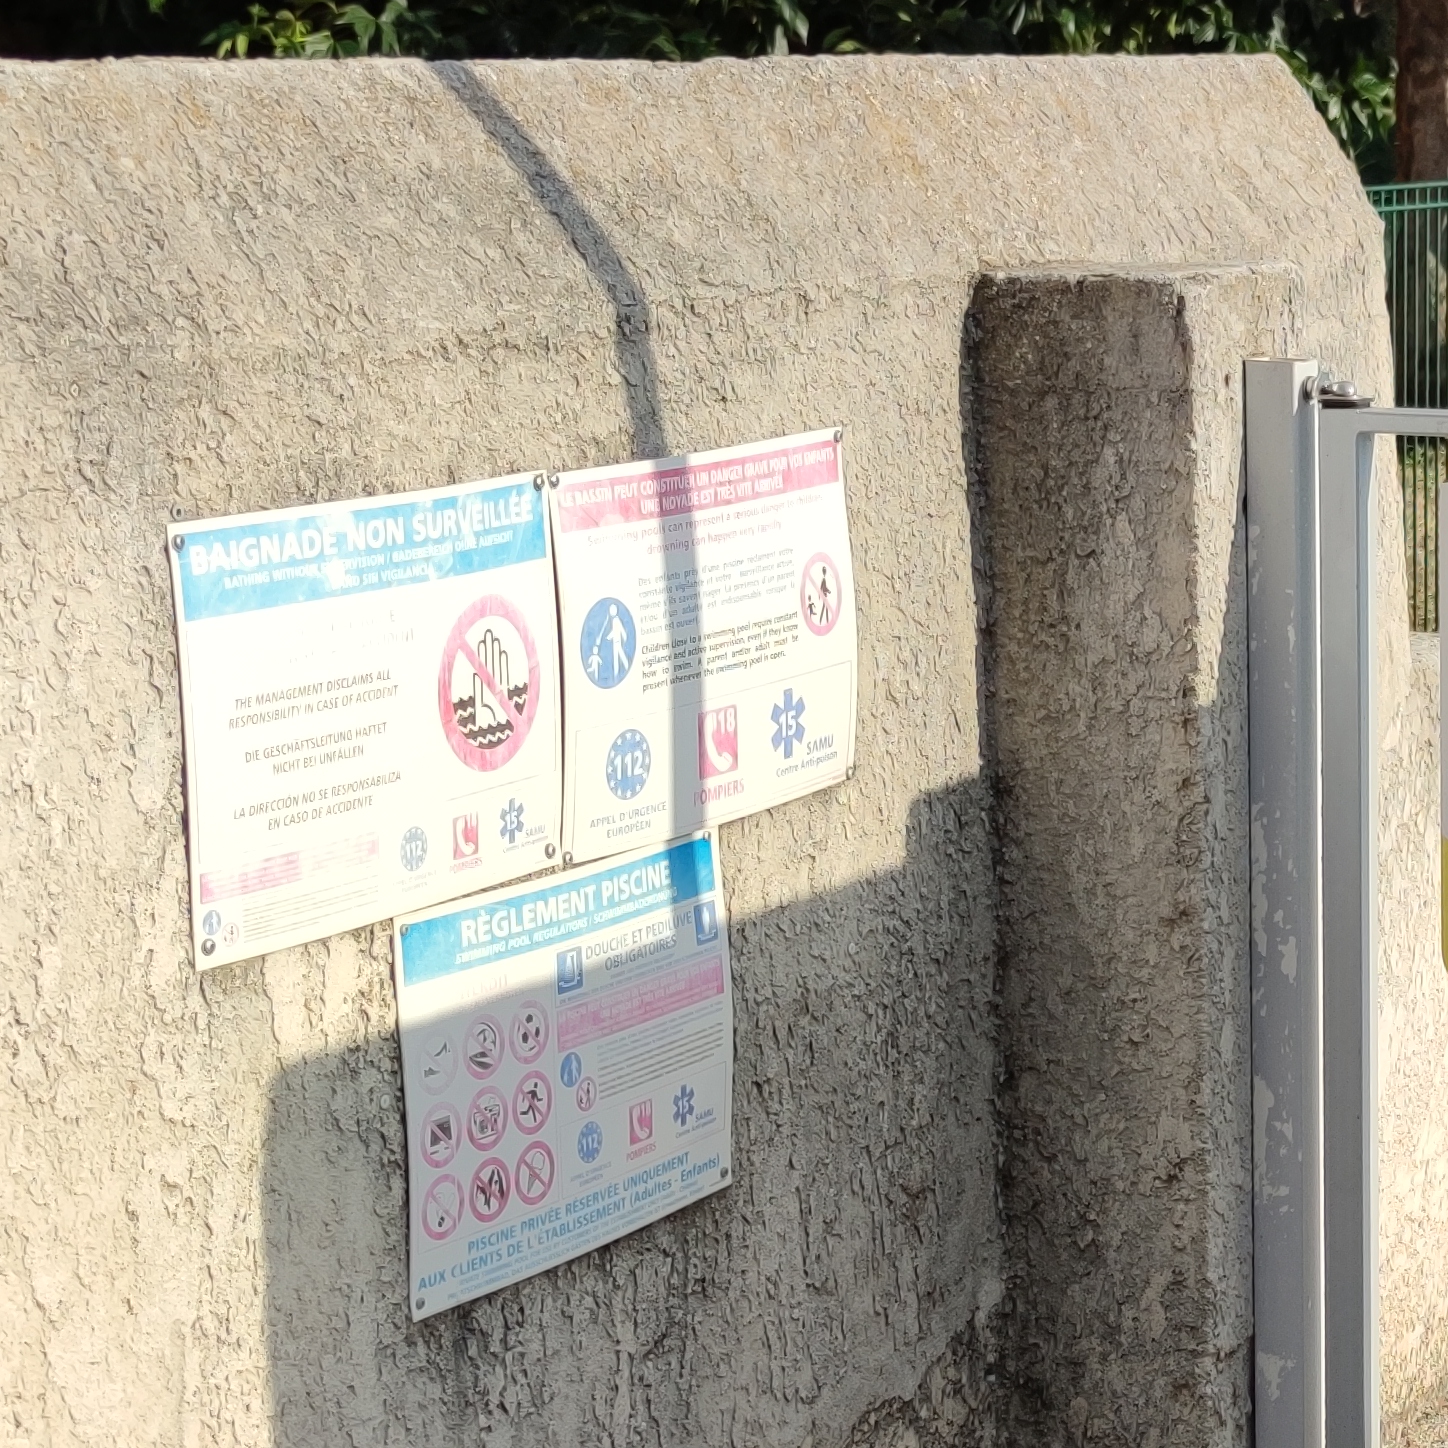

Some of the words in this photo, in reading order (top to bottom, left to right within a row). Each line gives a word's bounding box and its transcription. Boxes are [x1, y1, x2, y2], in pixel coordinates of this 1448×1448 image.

[614, 482, 638, 501] PEUT
[640, 472, 694, 495] CONSTITUER
[697, 470, 708, 486] UN
[712, 464, 742, 484] DANGER
[789, 452, 803, 470] VOS
[640, 498, 660, 515] UNE
[663, 492, 698, 511] NOYADE
[700, 488, 714, 504] EST
[717, 482, 735, 501] TRÈS
[189, 526, 338, 576] BAIGNADE
[347, 517, 405, 551] NON
[412, 489, 533, 542] SURVEILLÉE
[668, 521, 683, 532] can
[647, 538, 689, 554] drowning
[235, 697, 252, 711] THE
[256, 682, 324, 705] MANAGEMENT
[327, 673, 373, 692] DISCLAIMS
[376, 668, 391, 681] ALL
[228, 706, 301, 731] RESPONSIBILITY
[305, 703, 313, 715] IN
[317, 697, 338, 711] CASE
[342, 693, 353, 706] OF
[356, 685, 398, 703] ACCIDENT
[718, 708, 735, 734] 18
[779, 710, 796, 738] 15
[245, 750, 259, 763] DIE
[355, 722, 387, 740] HAFTET
[807, 733, 833, 755] SAMU
[273, 759, 300, 776] NICHT
[303, 756, 316, 768] BEI
[614, 751, 643, 780] 112
[776, 764, 799, 777] Centre
[234, 808, 245, 819] LA
[249, 794, 299, 816] DIRECCIÓN
[302, 791, 315, 805] NO
[318, 788, 329, 800] SE
[332, 770, 401, 797] RESPONSABILIZA
[694, 778, 744, 807] POMPIERS
[268, 818, 280, 830] EN
[284, 811, 308, 827] CASO
[312, 807, 323, 820] DE
[326, 795, 373, 816] ACCIDENTE
[506, 811, 518, 830] 15
[590, 812, 616, 828] APPEL
[620, 801, 667, 822] D'URGENCE
[607, 819, 651, 838] EUROPÉEN
[460, 884, 597, 948] RÈGLEMENT
[601, 860, 670, 906] PISCINE
[508, 933, 531, 950] POOL
[586, 932, 629, 960] DOUCHE
[632, 928, 643, 945] ET
[605, 934, 677, 971] OBLIGATOIRES
[582, 1134, 598, 1154] 112
[468, 1224, 517, 1254] PISCINE
[520, 1206, 562, 1236] PRIVÉE
[566, 1182, 620, 1218] RÉSERVÉE
[623, 1151, 690, 1192] UNIQUEMENT
[417, 1269, 447, 1292] AUX
[451, 1249, 502, 1278] CLIENTS
[507, 1240, 524, 1258] DE
[527, 1196, 627, 1249] L'ÉTABLISSEMENT
[630, 1179, 672, 1208] (Adultes
[681, 1152, 720, 1182] Enfants)
